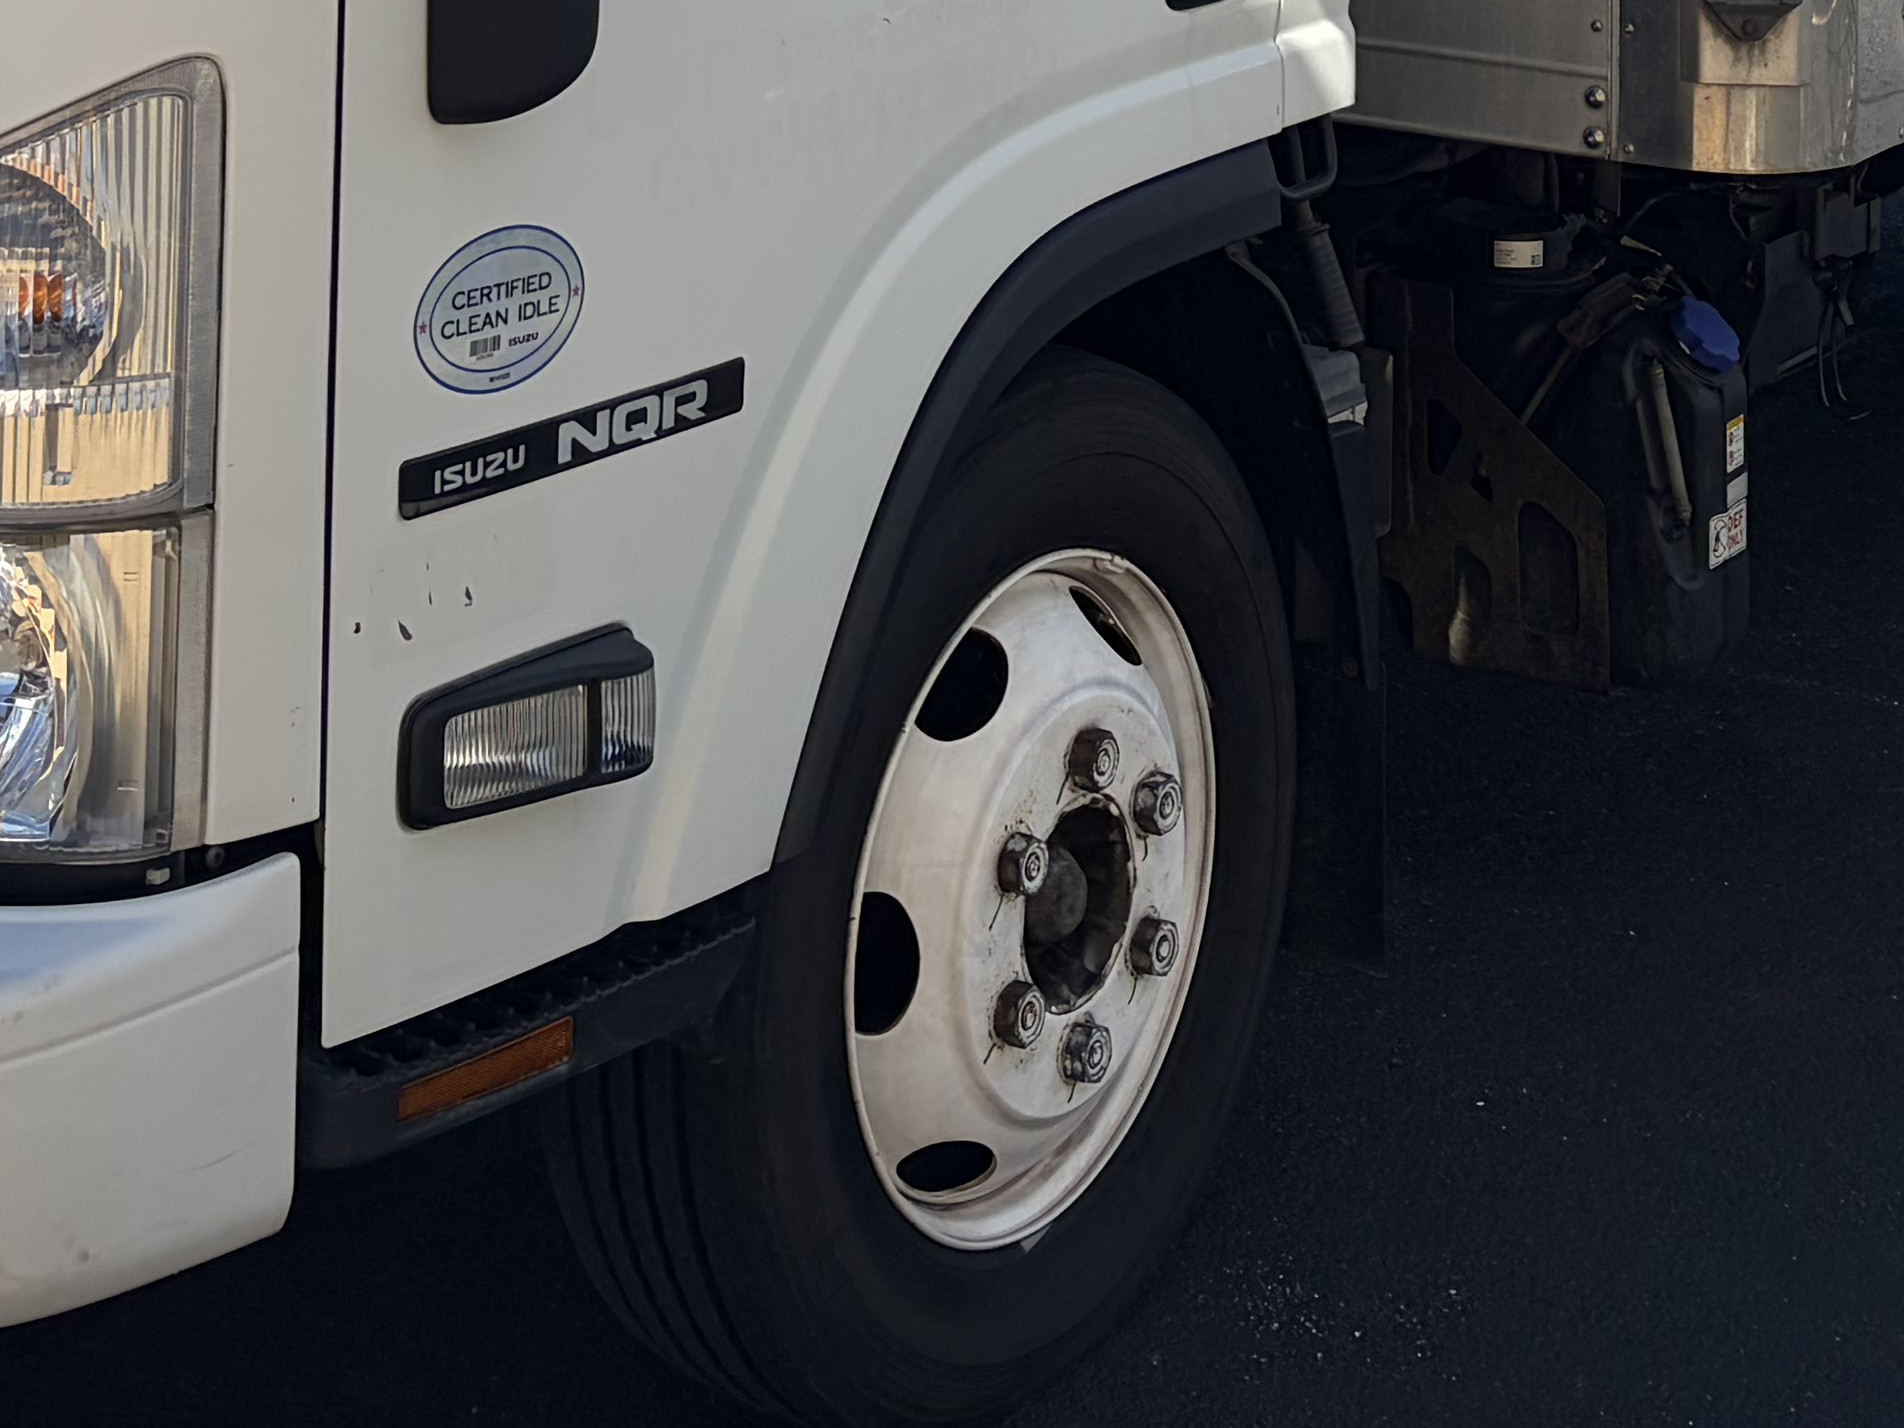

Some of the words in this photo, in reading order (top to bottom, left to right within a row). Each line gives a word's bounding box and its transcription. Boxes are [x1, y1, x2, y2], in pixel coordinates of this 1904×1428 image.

[451, 271, 553, 312] CERTIFIED
[440, 308, 510, 341] CLEAN
[517, 294, 562, 323] IDLE
[508, 331, 539, 348] ISUZU
[434, 444, 527, 495] ISUZU
[557, 378, 709, 466] NQR
